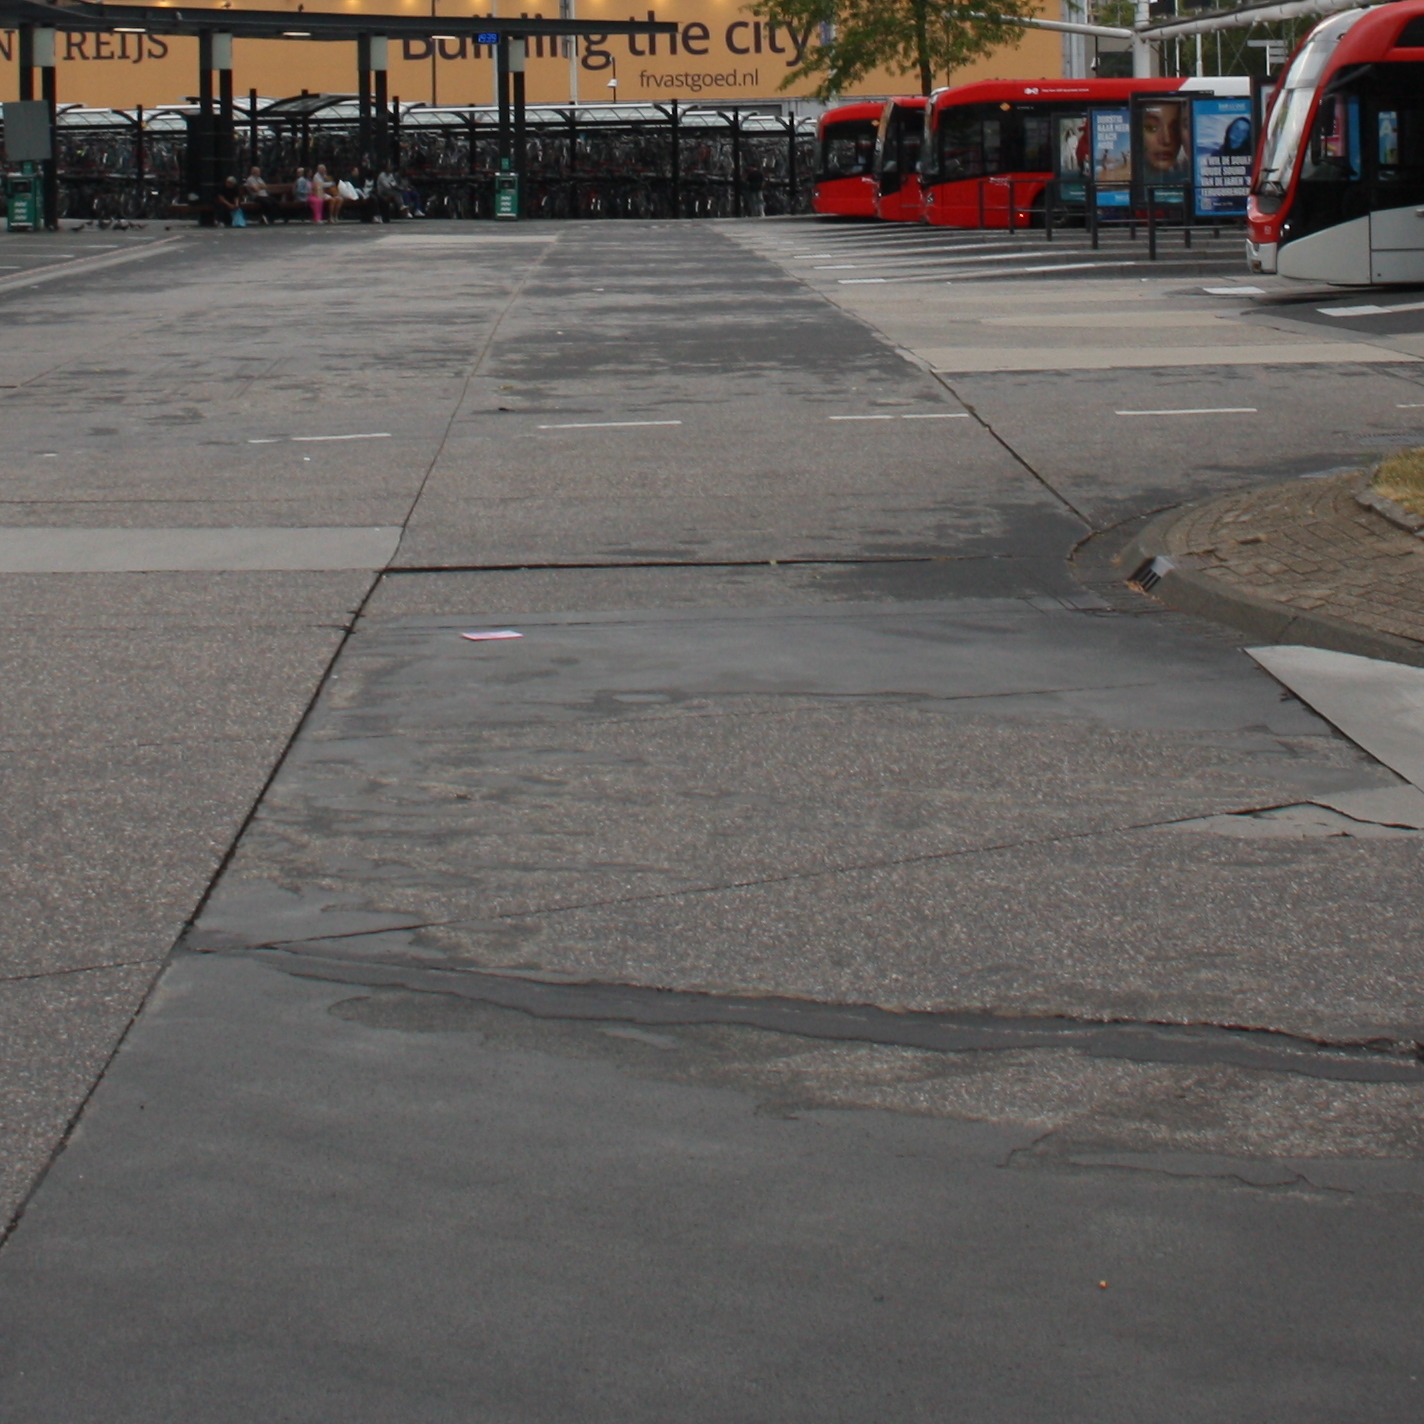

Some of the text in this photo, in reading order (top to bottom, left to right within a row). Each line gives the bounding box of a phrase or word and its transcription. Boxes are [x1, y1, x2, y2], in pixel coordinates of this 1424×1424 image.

[62, 31, 169, 64] REIJS
[627, 11, 711, 56] the
[725, 12, 812, 67] city
[639, 69, 759, 94] frvastgoed.nl
